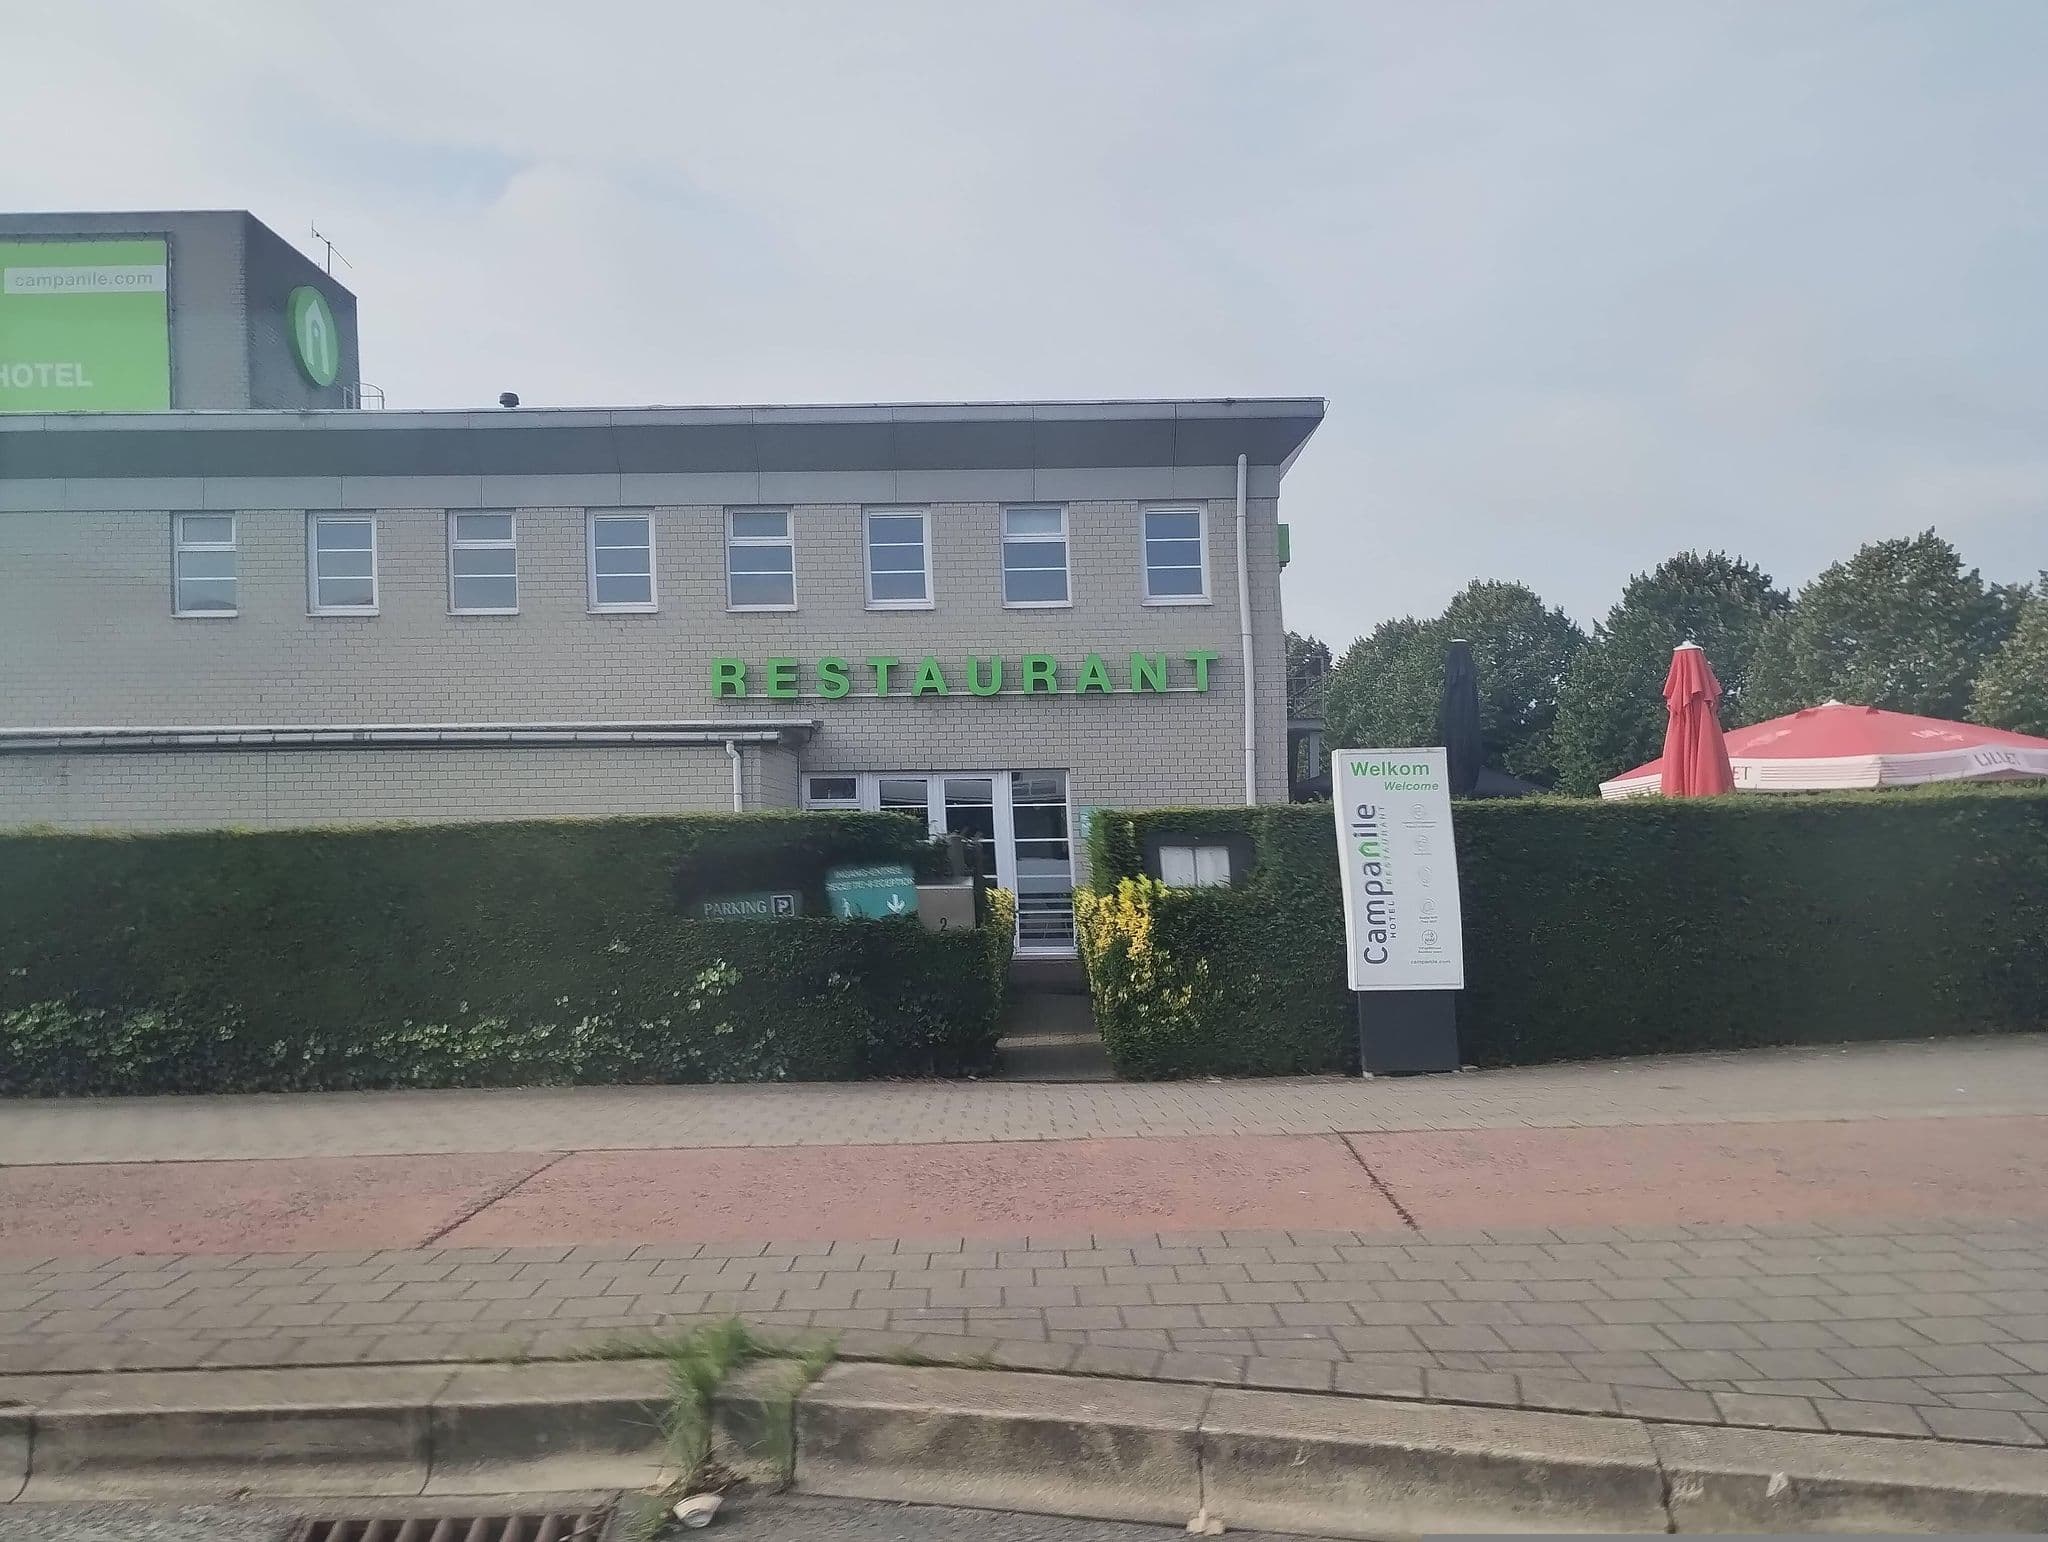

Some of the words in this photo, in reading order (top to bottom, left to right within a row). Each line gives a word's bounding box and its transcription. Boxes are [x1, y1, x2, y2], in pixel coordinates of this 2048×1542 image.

[15, 271, 153, 289] campanile.com
[0, 362, 93, 387] HOTEL
[711, 650, 1218, 699] RESTAURANT
[1350, 761, 1430, 777] Welkom
[1383, 781, 1440, 792] Welcome
[703, 900, 767, 916] PARKING
[940, 917, 948, 931] 2
[1389, 901, 1397, 939] HOTEL
